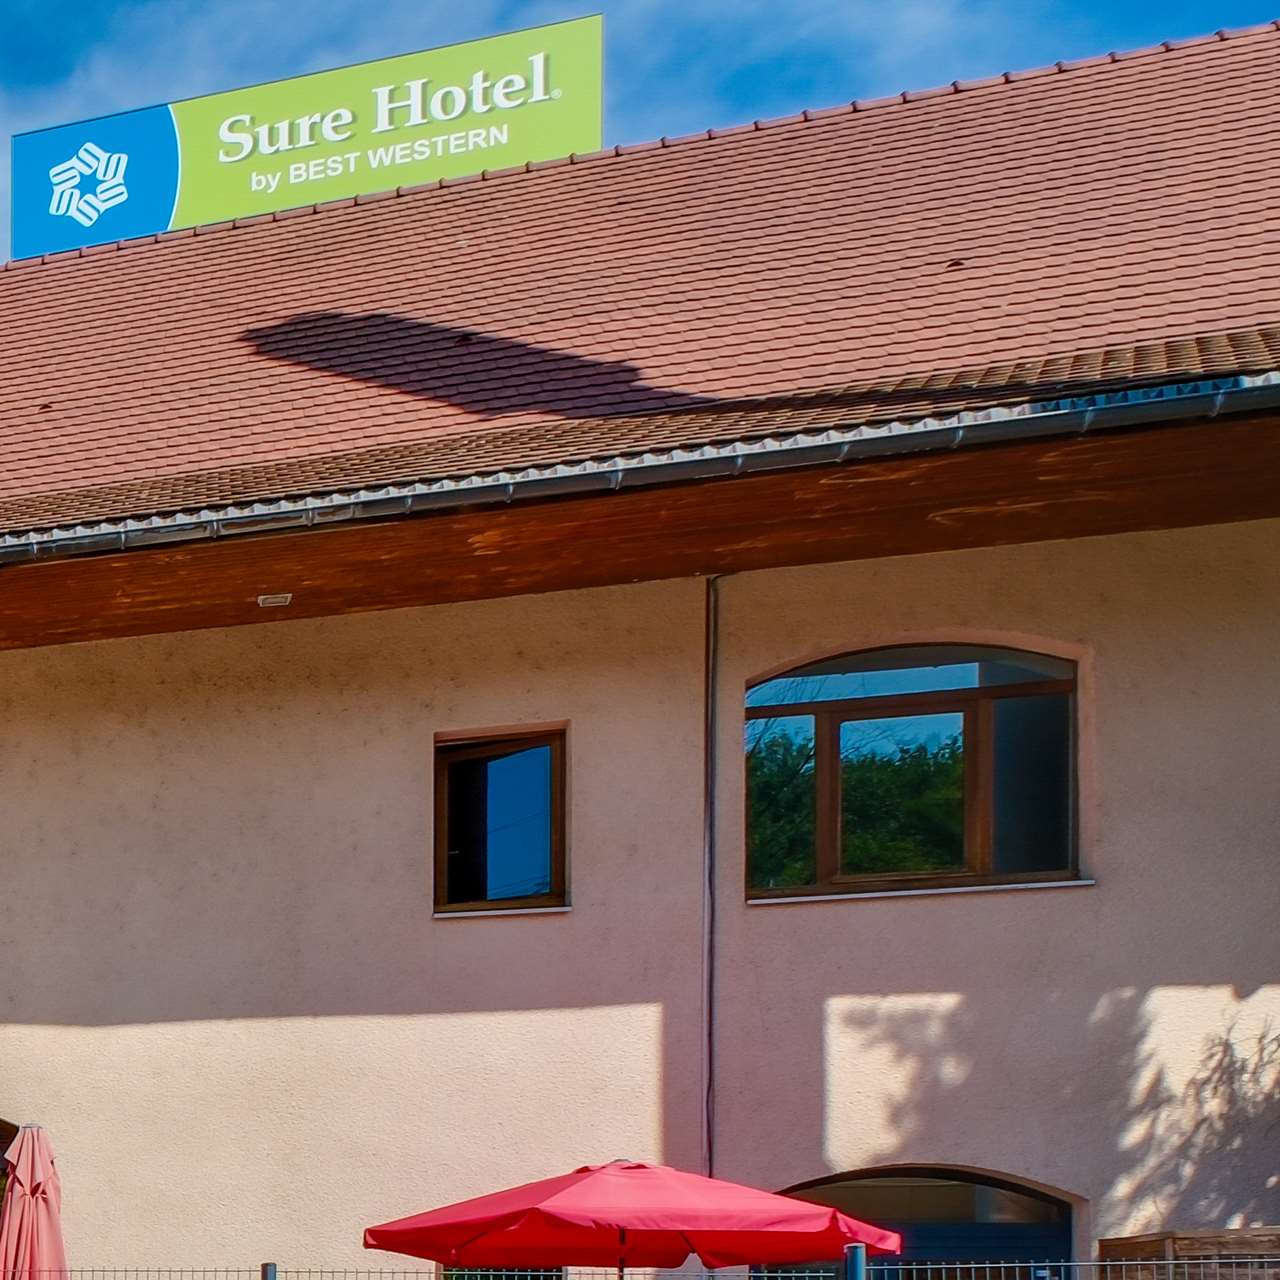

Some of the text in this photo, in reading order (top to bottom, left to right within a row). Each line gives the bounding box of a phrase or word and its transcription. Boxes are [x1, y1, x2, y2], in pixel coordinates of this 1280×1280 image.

[218, 52, 551, 163] Sure Hotel
[251, 124, 509, 193] by BEST WESTERN
